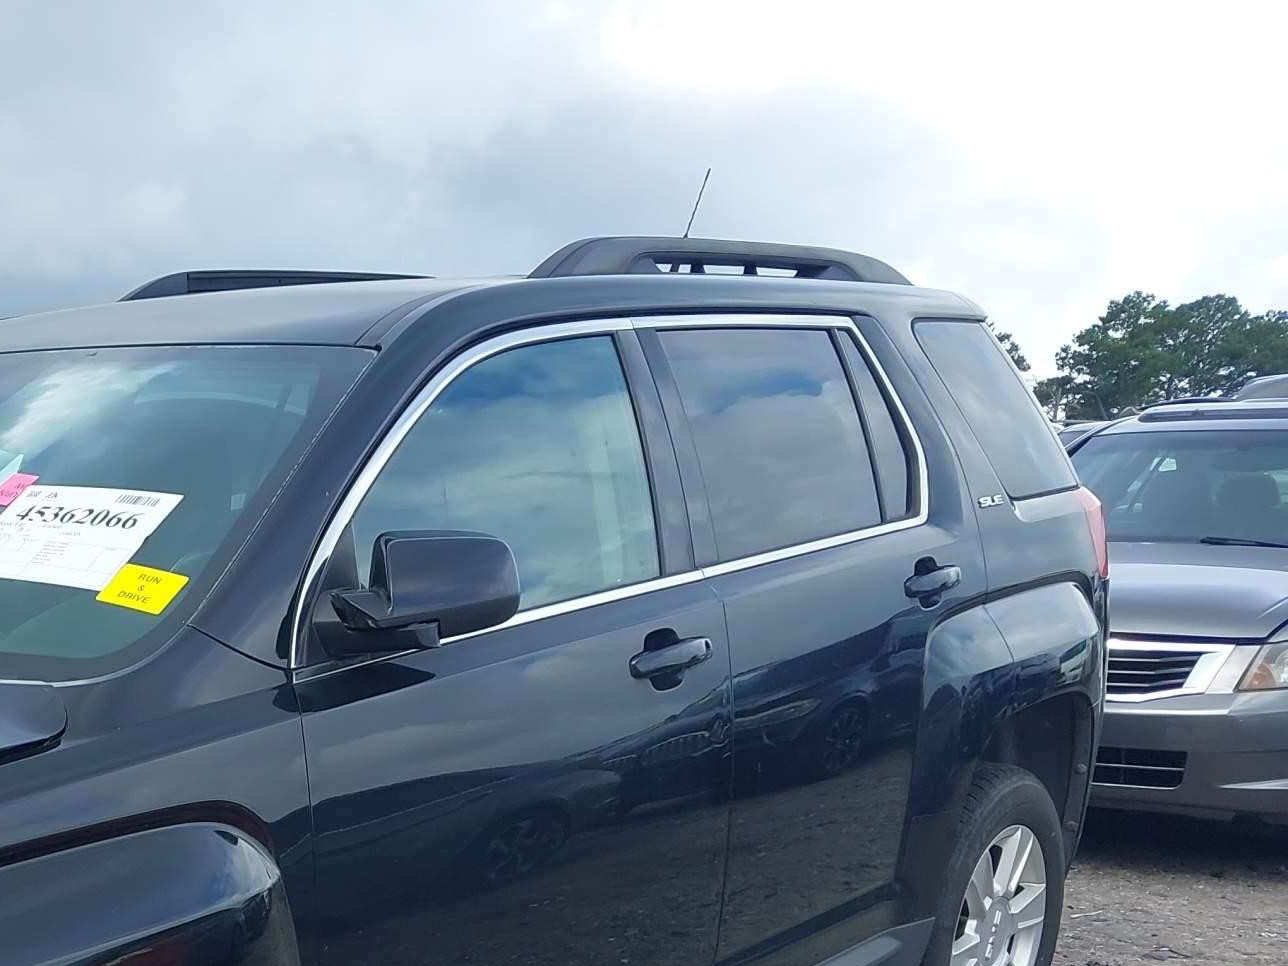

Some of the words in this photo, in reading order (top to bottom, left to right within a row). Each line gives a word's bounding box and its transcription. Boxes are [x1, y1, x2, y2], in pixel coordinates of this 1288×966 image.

[979, 495, 1003, 507] SLE
[15, 505, 144, 529] 45362066
[137, 573, 161, 584] RUN
[117, 591, 151, 604] DRIVE
